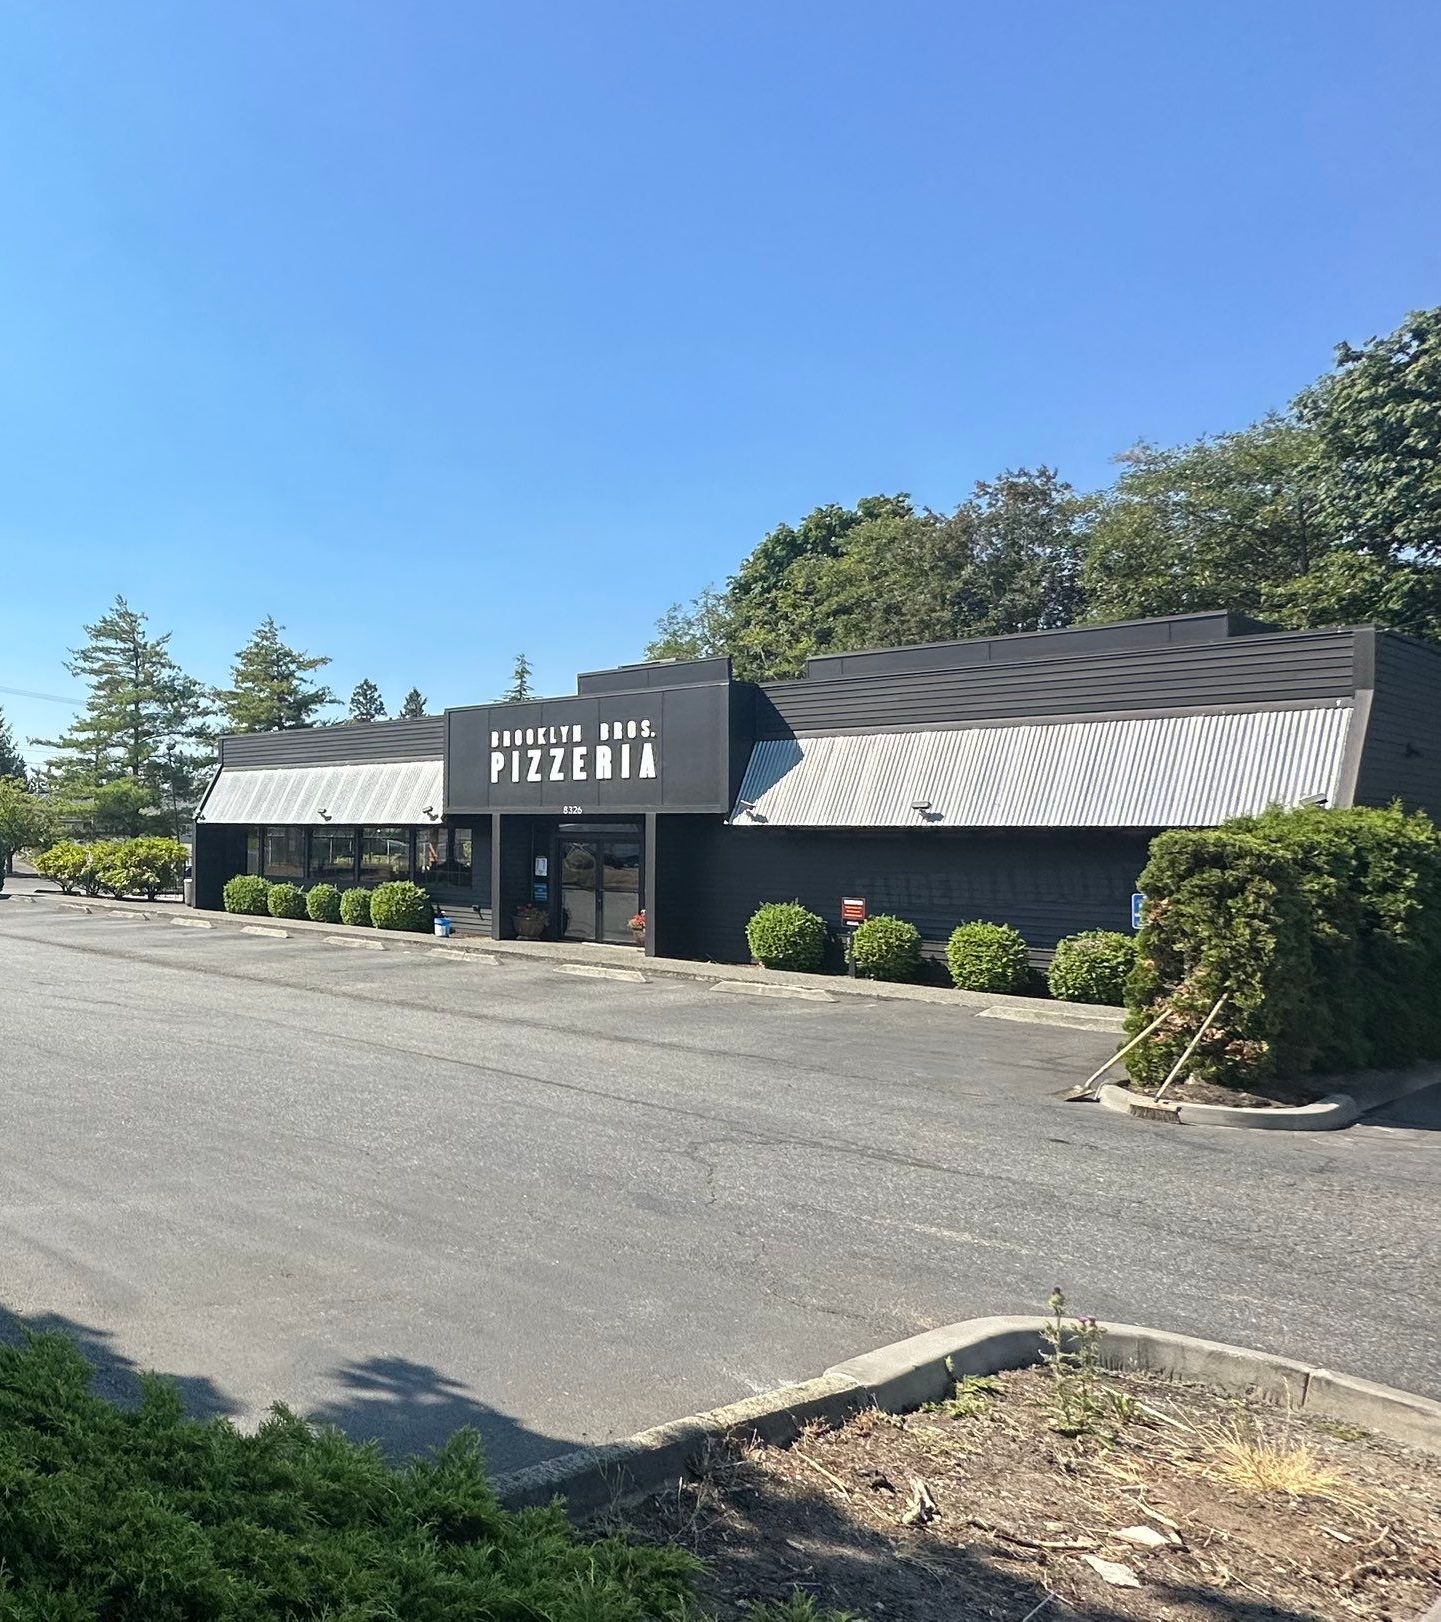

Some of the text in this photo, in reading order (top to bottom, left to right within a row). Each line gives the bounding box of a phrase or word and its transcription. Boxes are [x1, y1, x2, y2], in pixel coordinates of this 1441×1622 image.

[491, 719, 656, 748] BROOKLYN BROS.
[490, 743, 656, 783] PIZZERIA
[563, 805, 583, 815] 8326
